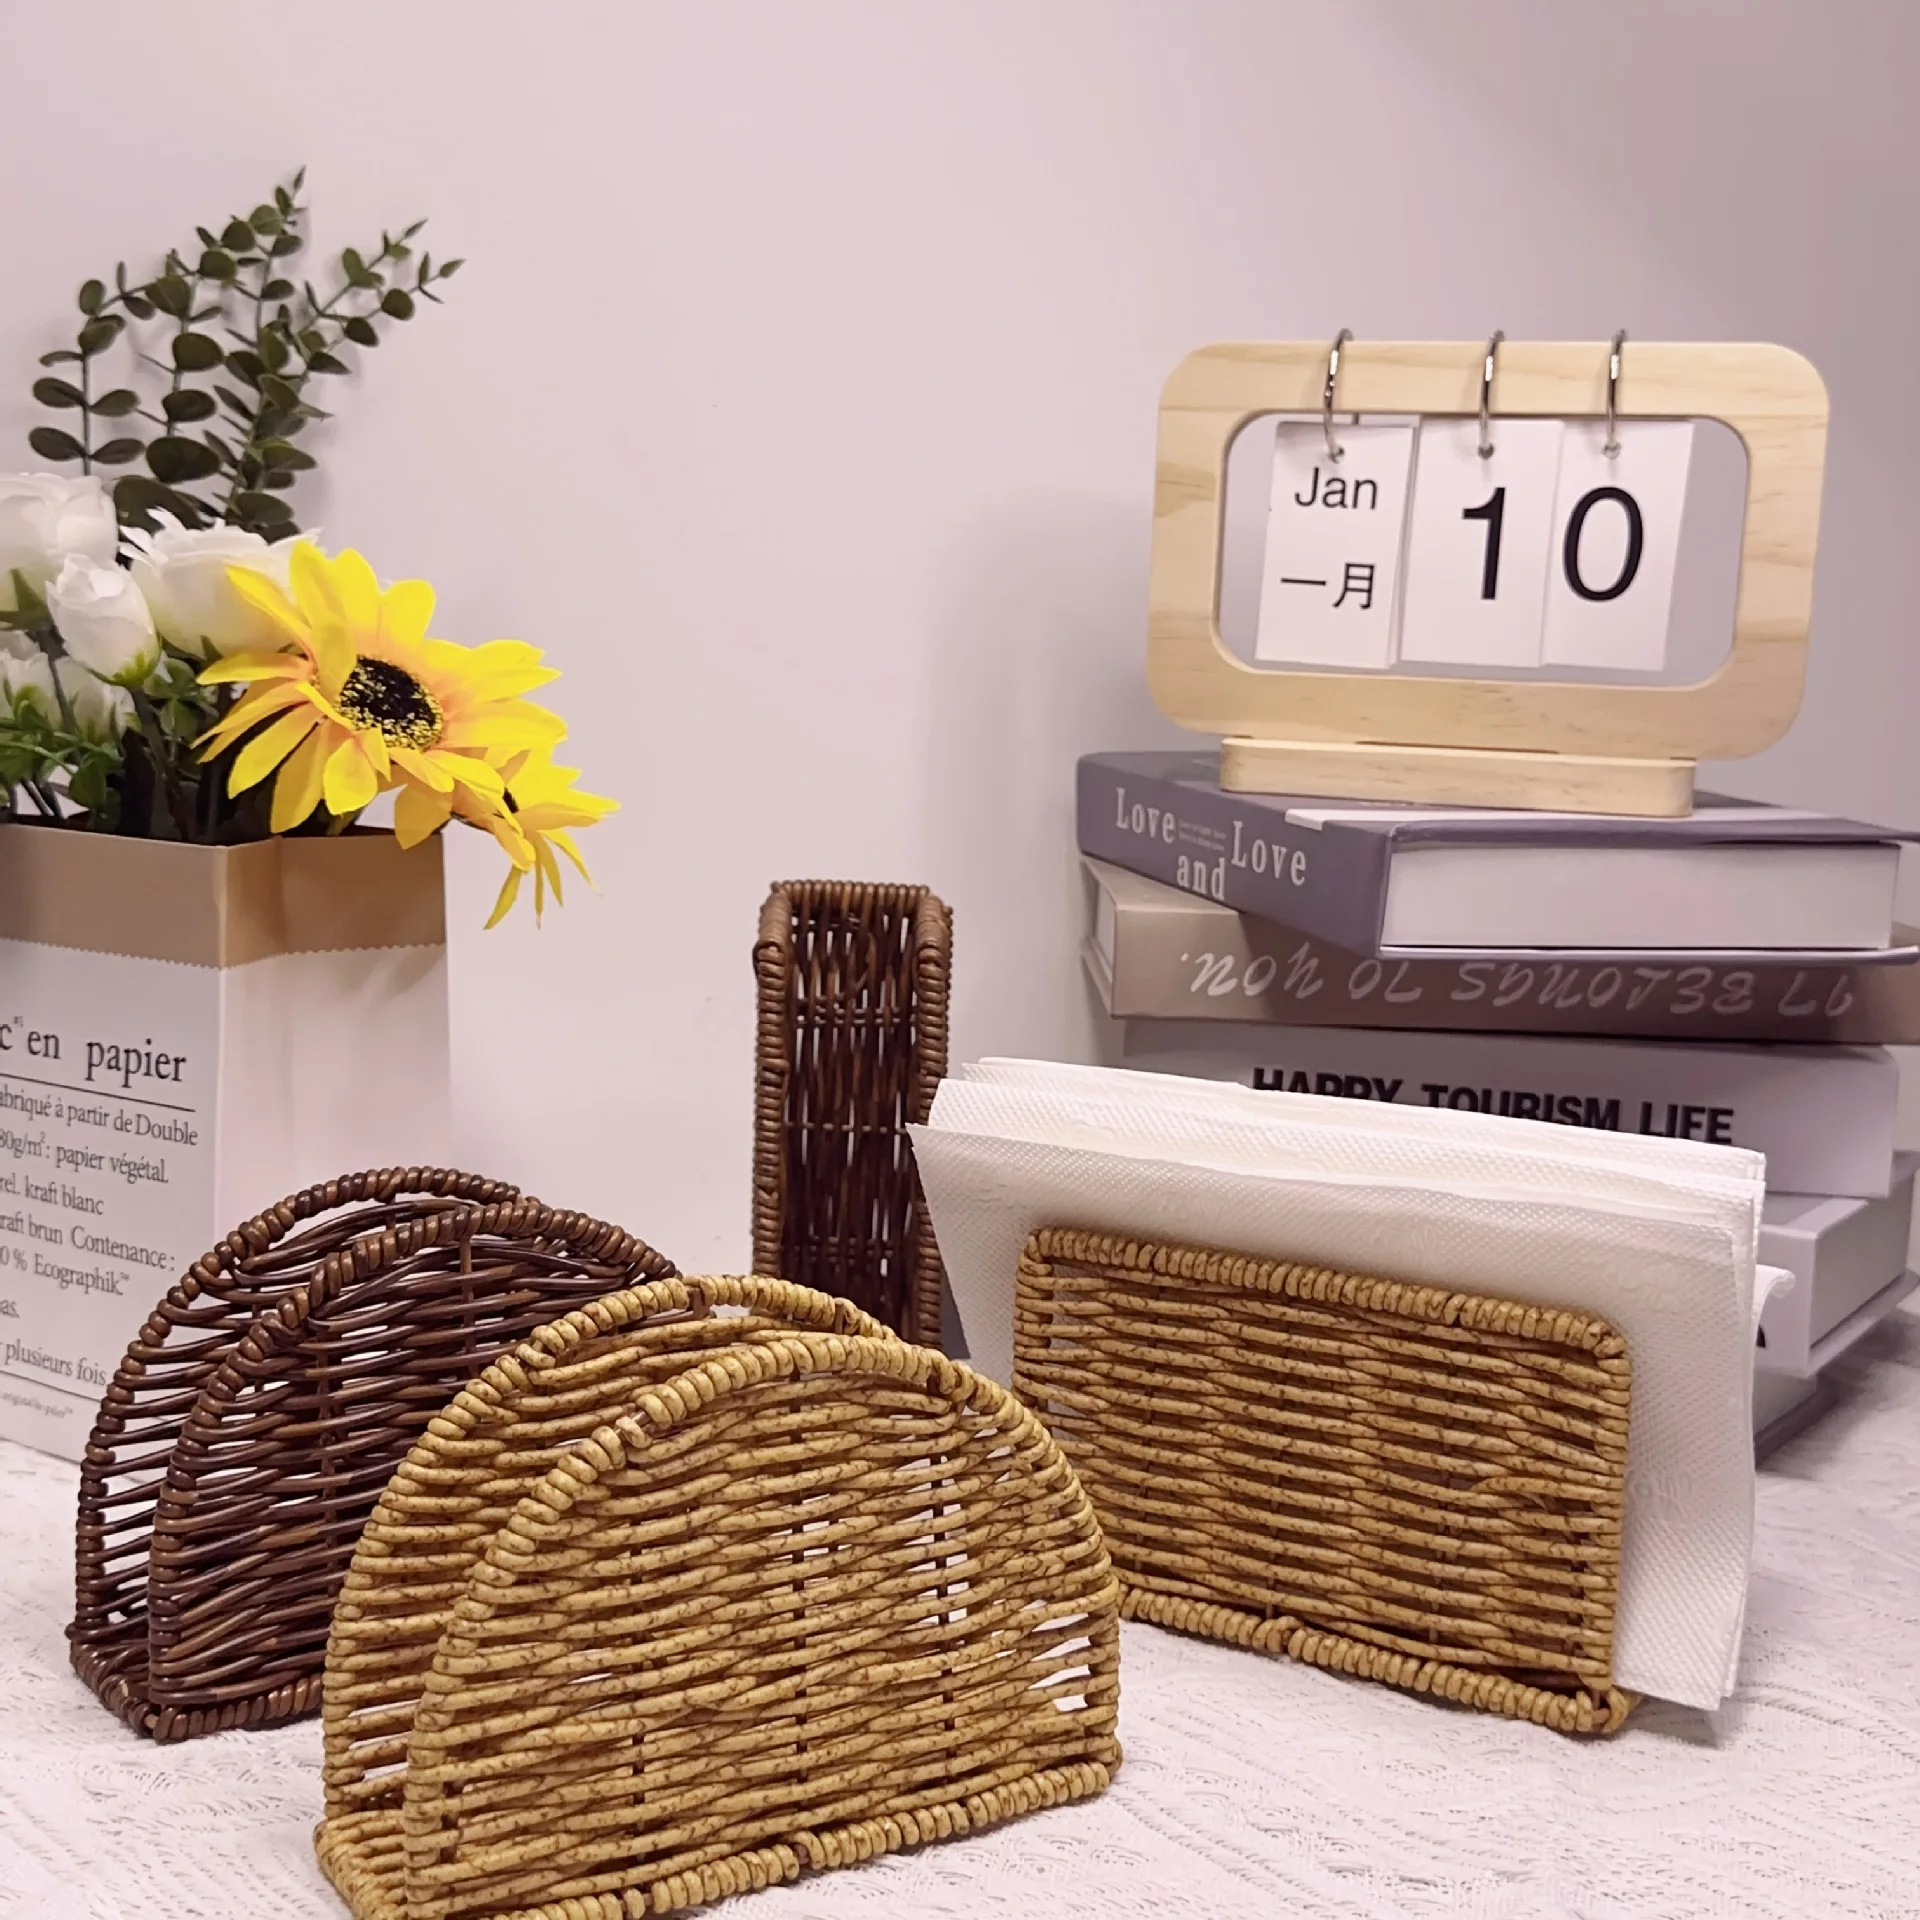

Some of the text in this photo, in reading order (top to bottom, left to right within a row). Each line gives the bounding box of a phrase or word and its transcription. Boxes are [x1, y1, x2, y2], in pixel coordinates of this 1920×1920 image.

[1293, 466, 1379, 511] Jan
[1280, 561, 1376, 611] 一月
[1115, 786, 1307, 901] Love and Love
[1180, 941, 1854, 1017] IT BELONGS TO YOU.
[27, 1030, 62, 1060] en
[85, 1037, 187, 1089] papier
[67, 1104, 110, 1128] partir
[113, 1108, 133, 1134] de
[135, 1112, 199, 1146] Double
[1252, 1067, 1735, 1145] HAPPY TOURISM LIFE
[55, 1145, 105, 1173] papier
[25, 1174, 58, 1205] kraft
[61, 1184, 104, 1216] blanc
[28, 1213, 63, 1245] brun
[4, 1338, 107, 1387] plusieurs fois
